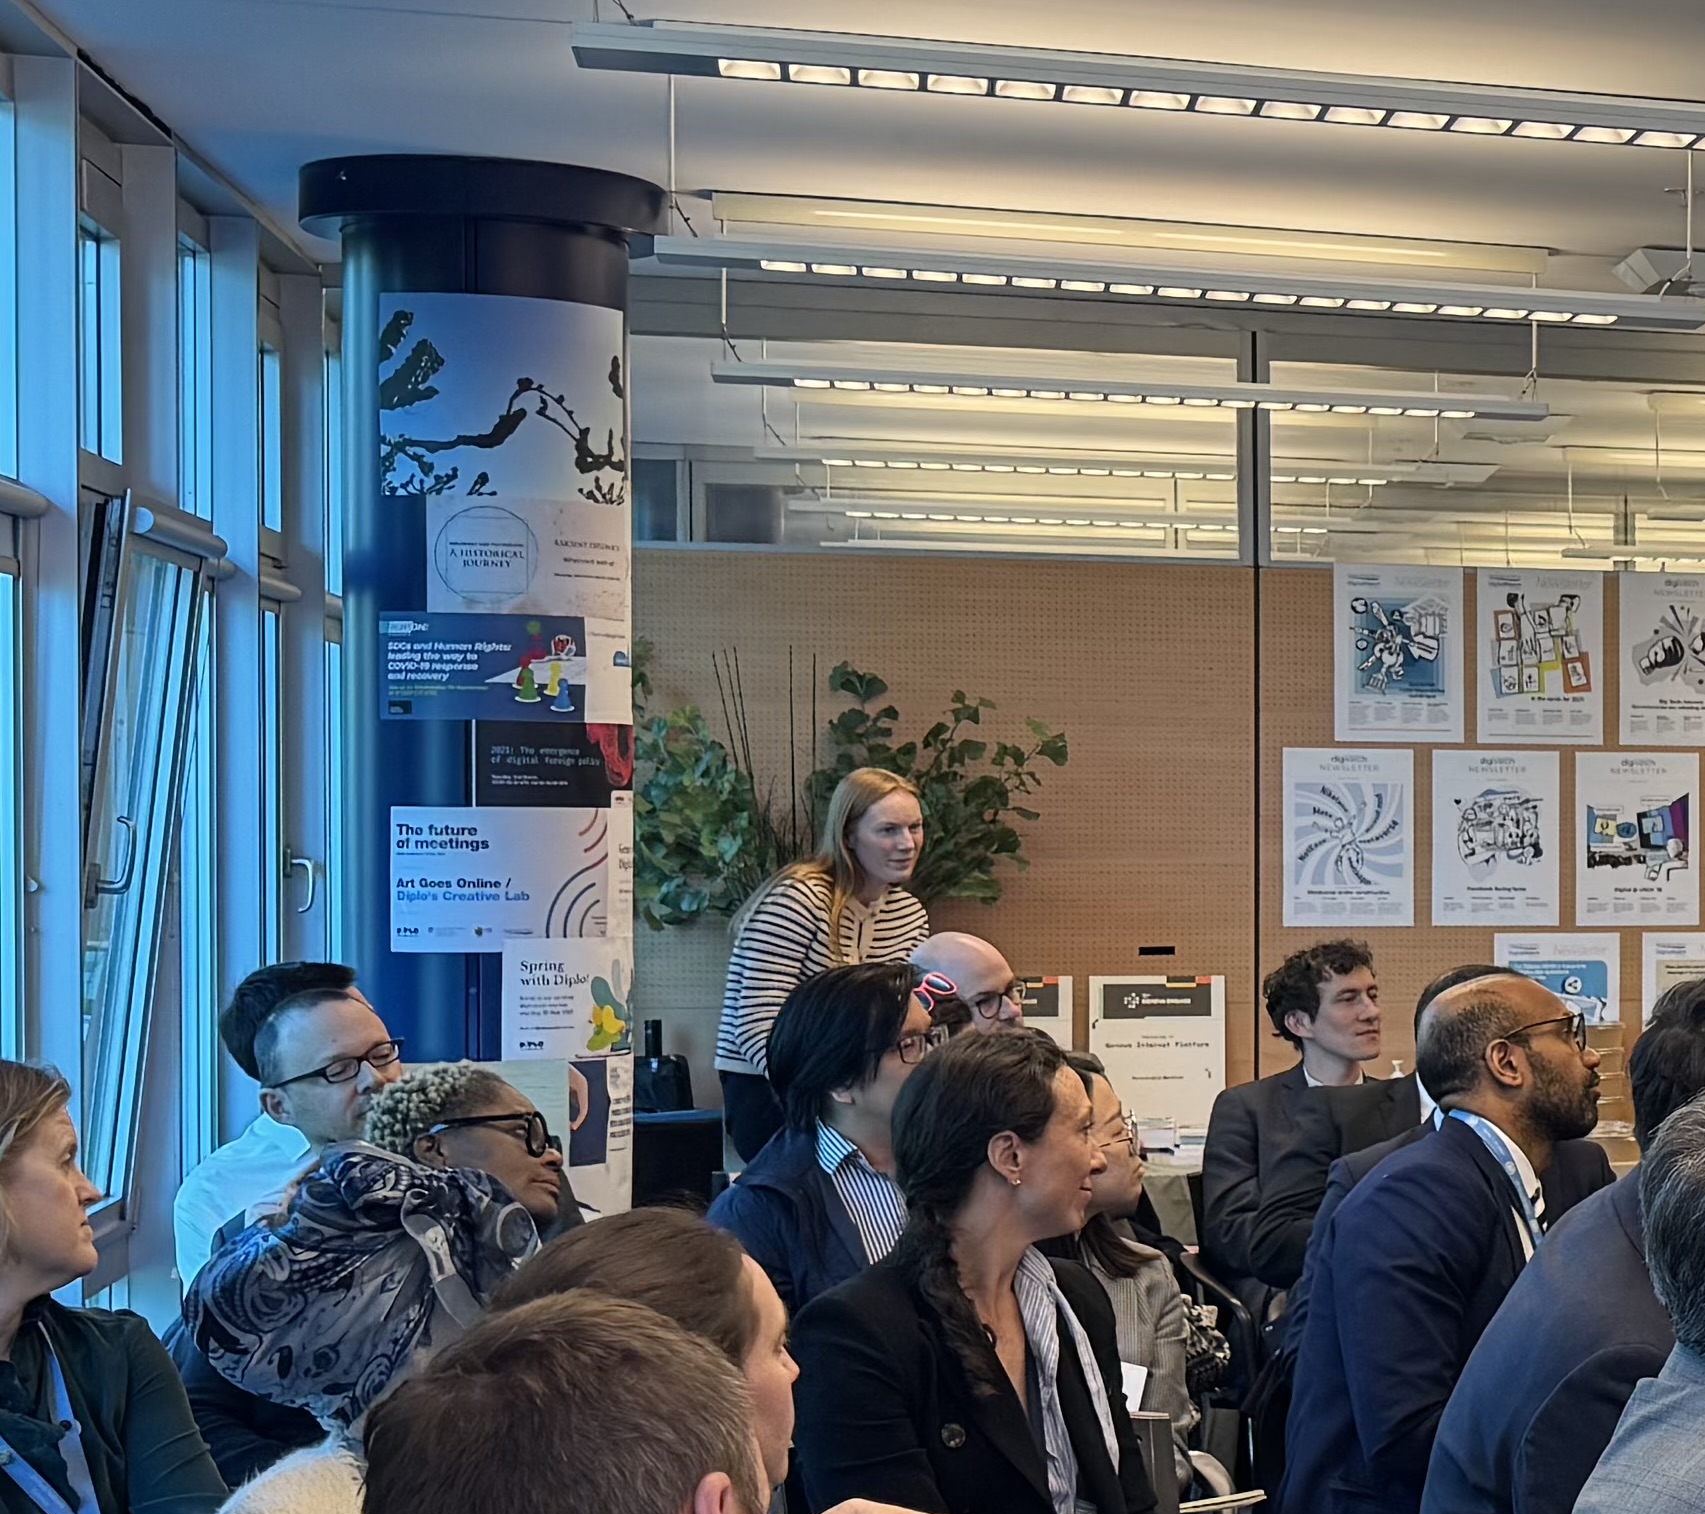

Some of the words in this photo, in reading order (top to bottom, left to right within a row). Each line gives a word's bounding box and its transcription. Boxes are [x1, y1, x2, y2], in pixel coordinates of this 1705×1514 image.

[450, 549, 457, 558] A
[460, 549, 524, 559] HISTORICAL
[463, 559, 511, 568] JOURNEY
[413, 642, 432, 651] and
[433, 642, 472, 651] Human
[423, 652, 440, 660] the
[441, 653, 464, 662] way
[466, 652, 478, 660] to
[387, 662, 430, 671] COVID-19
[432, 663, 478, 672] response
[387, 672, 405, 680] and
[406, 672, 450, 682] recovery
[520, 746, 534, 754] The
[506, 756, 538, 765] digital
[396, 824, 423, 836] The
[428, 824, 478, 836] future
[396, 838, 412, 849] of
[415, 838, 490, 852] meetings
[396, 877, 415, 888] Art
[419, 878, 452, 889] Goes
[456, 878, 502, 889] Online
[396, 890, 439, 902] Diplo's
[442, 890, 500, 901] Creative
[505, 890, 530, 901] Lab
[520, 960, 564, 974] Spring
[520, 974, 550, 986] with
[554, 974, 589, 988] Diplo!
